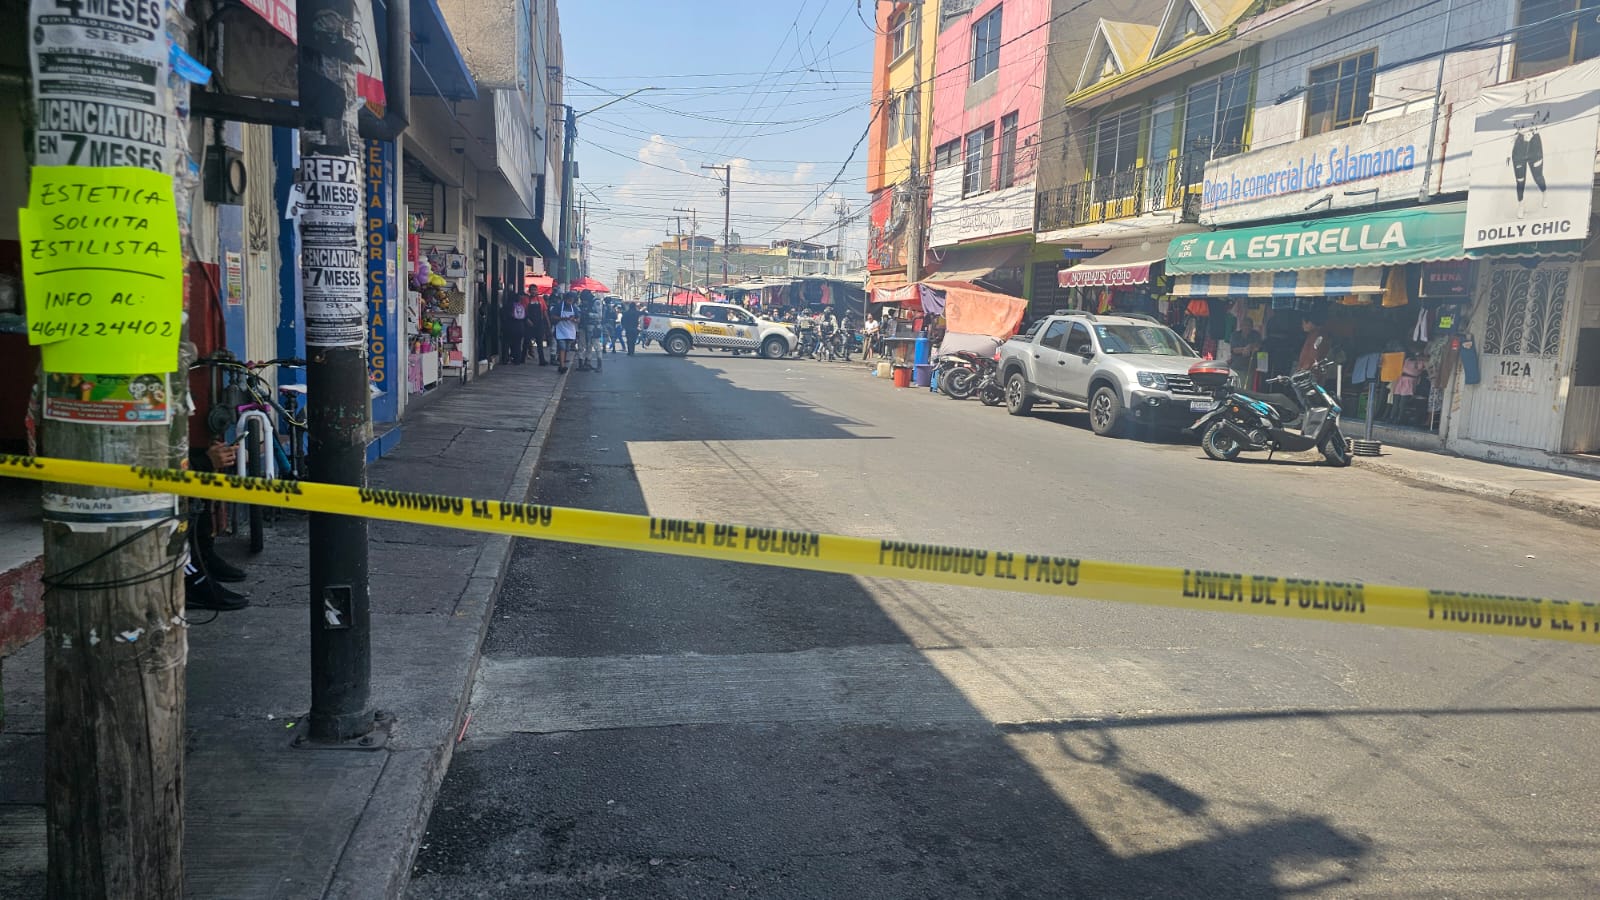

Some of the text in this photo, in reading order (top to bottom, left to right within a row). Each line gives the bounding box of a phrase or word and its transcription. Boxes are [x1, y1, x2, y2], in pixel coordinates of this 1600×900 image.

[85, 29, 139, 45] SEP
[40, 98, 166, 147] LICENCIATURA
[38, 133, 162, 173] EN 7 MESES
[303, 159, 357, 183] REPA
[1204, 144, 1415, 210] Ropa la comercial de Salamanca
[41, 183, 168, 206] ESTETICA
[306, 183, 320, 204] 4
[321, 185, 358, 204] MESES
[52, 214, 149, 230] SOLICITA
[1477, 220, 1571, 242] DOLLY CHIC
[30, 239, 168, 260] ESTILISTA
[1205, 221, 1407, 261] LA ESTRELLA
[369, 139, 385, 382] ENTA POR CATALOGO
[309, 268, 323, 286] 7
[324, 270, 361, 286] MESES
[44, 291, 93, 310] INFO
[31, 320, 173, 337] 4641224402
[1500, 361, 1531, 377] 112-A
[713, 523, 738, 548] DE
[879, 539, 1081, 586] PROHIBIDO EL PASO
[1250, 575, 1279, 605] DE
